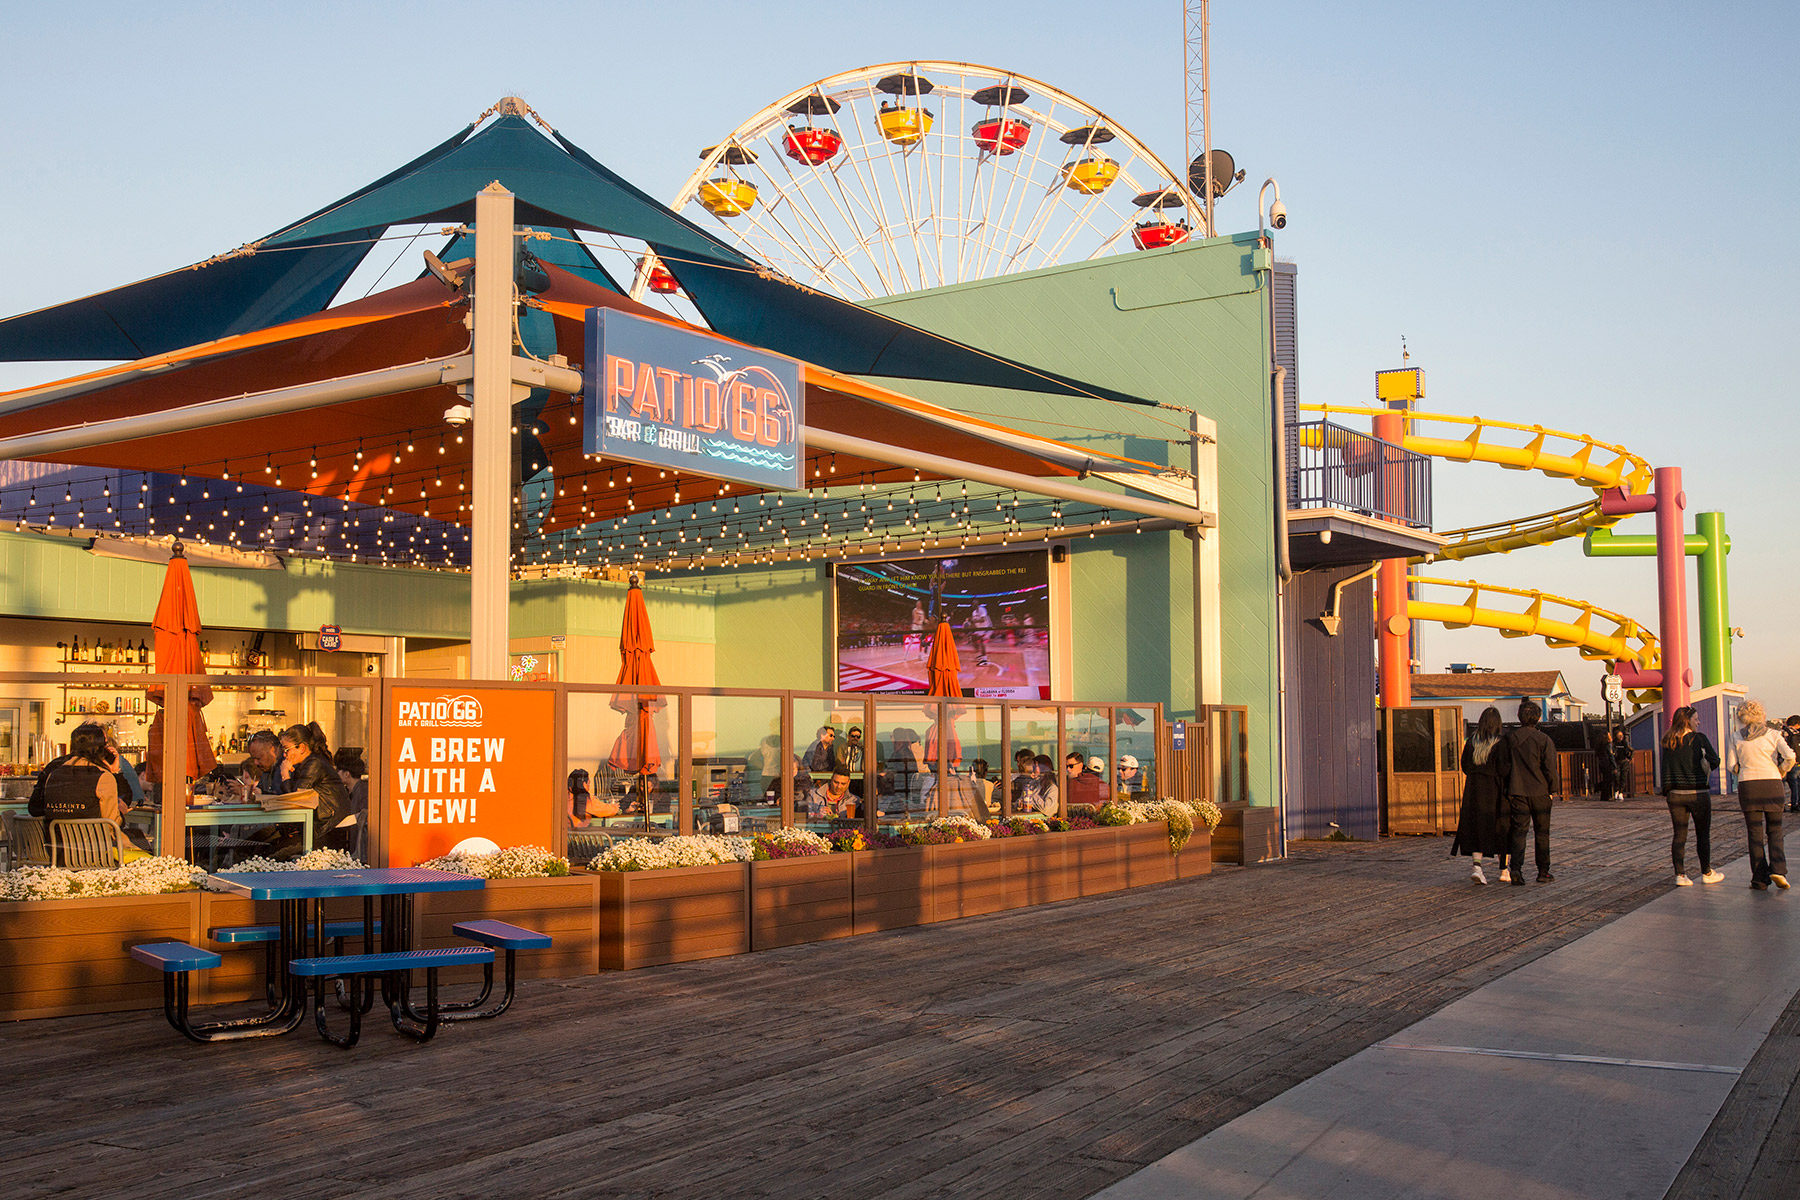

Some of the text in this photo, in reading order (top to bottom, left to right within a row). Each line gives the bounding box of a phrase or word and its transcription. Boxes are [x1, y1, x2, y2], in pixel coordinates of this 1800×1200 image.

[606, 354, 781, 447] PATIO 66
[606, 415, 641, 442] BAR
[658, 427, 702, 454] GRILL
[248, 654, 258, 664] 66
[1609, 690, 1619, 699] 66
[399, 700, 477, 720] PATIO 66
[398, 737, 505, 762] A BREW
[397, 768, 496, 793] WITH A
[46, 802, 86, 810] ALLSAINTS
[397, 798, 477, 824] VIEW!
